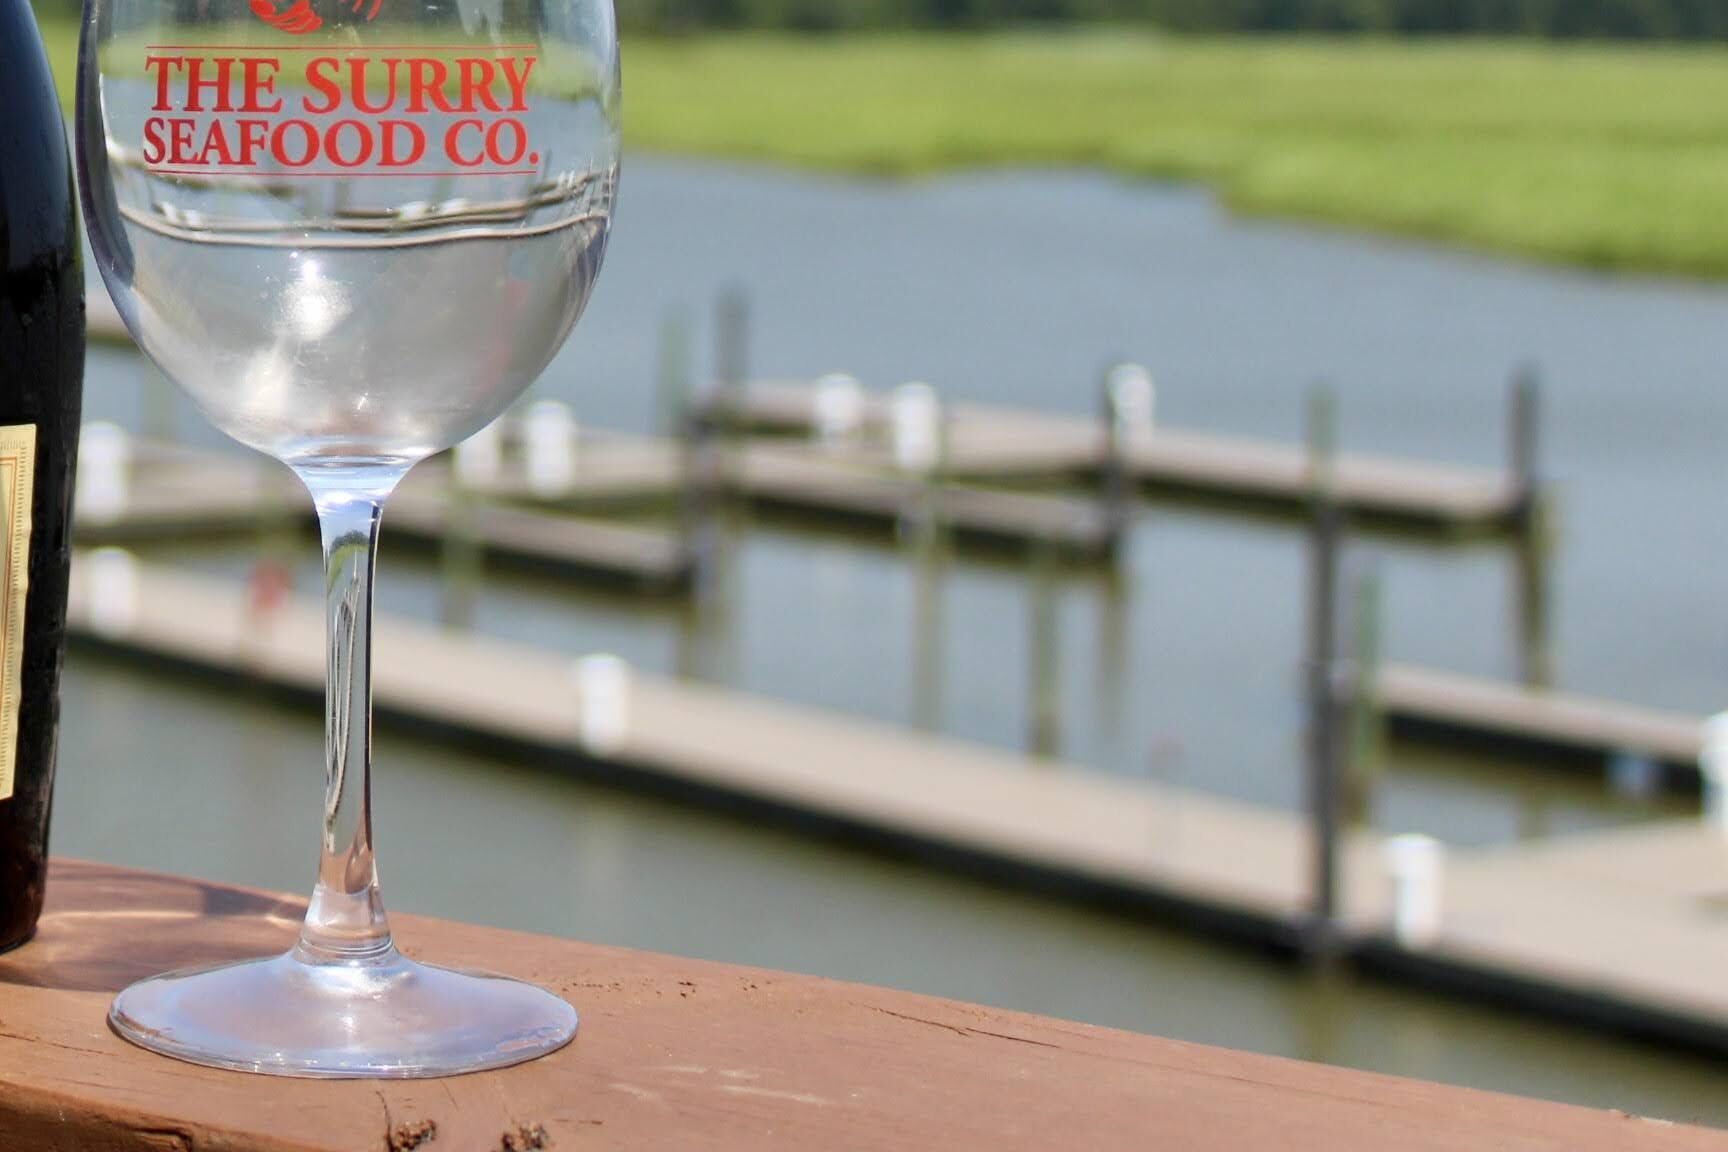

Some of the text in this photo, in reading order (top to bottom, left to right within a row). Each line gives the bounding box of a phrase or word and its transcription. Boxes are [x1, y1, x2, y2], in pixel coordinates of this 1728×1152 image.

[145, 56, 536, 114] THE SURRY
[144, 117, 539, 167] SEAFOOD CO.
